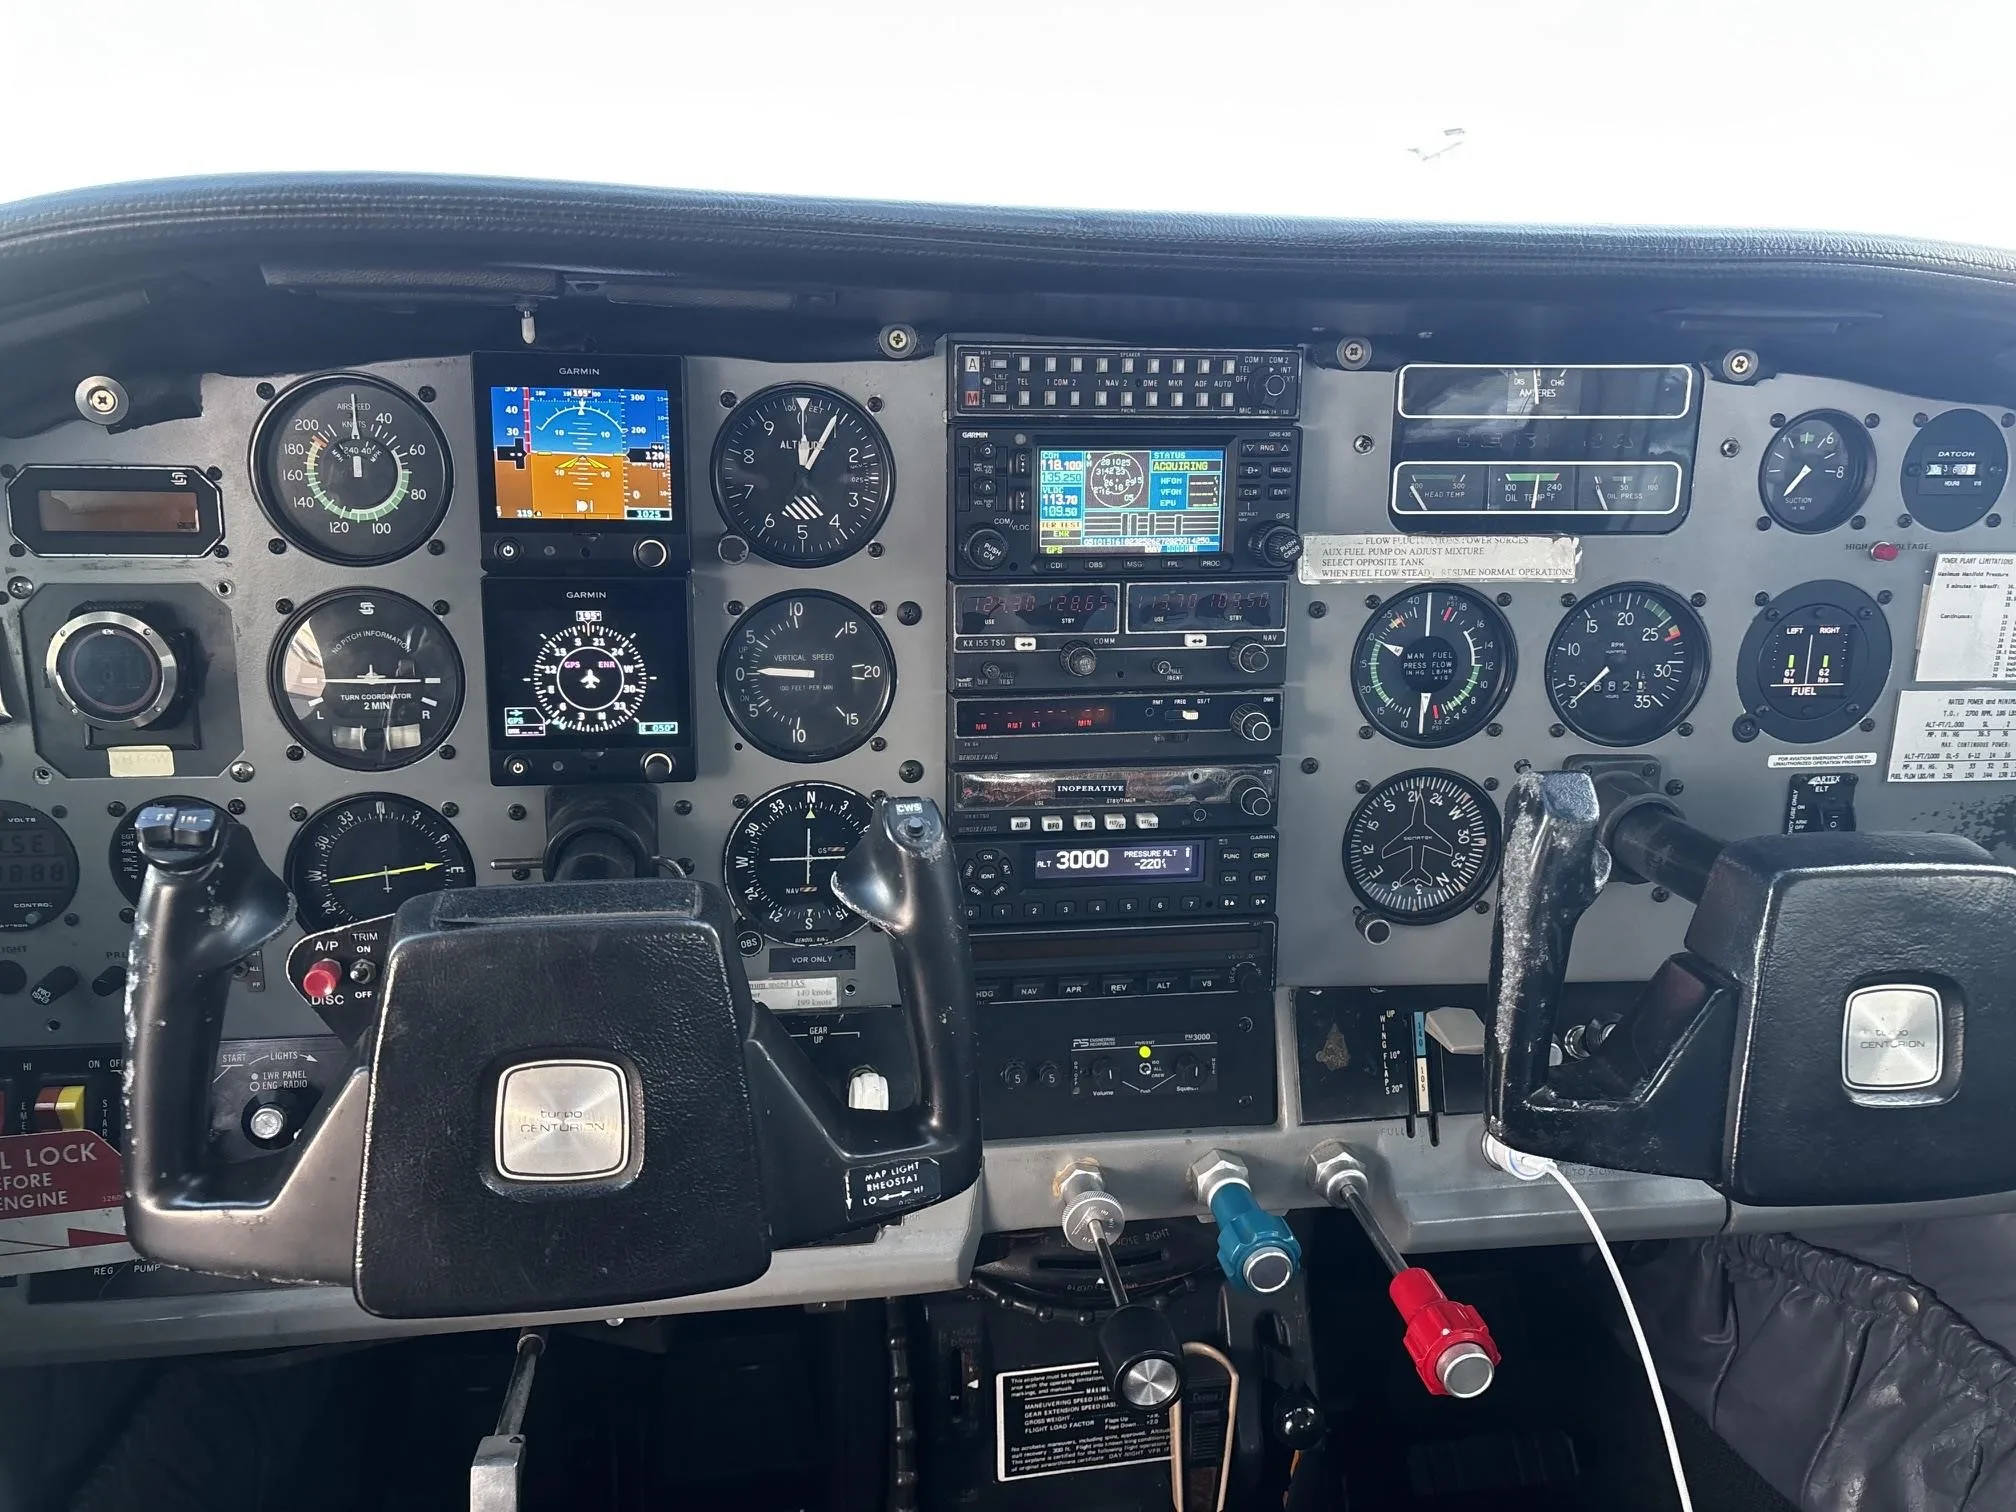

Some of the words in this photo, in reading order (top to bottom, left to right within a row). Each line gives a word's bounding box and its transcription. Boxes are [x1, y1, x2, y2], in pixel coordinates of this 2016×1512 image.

[376, 413, 392, 424] 40
[295, 419, 318, 431] 200
[764, 421, 775, 436] 9
[284, 444, 303, 454] 180
[410, 445, 425, 455] 60
[744, 449, 754, 464] 8
[849, 448, 858, 462] 2
[1042, 460, 1081, 470] 118.100
[1154, 462, 1208, 470] ACQUIRING
[283, 470, 303, 480] 160
[1042, 472, 1081, 482] 135.250
[411, 489, 426, 500] 80
[744, 485, 754, 499] 7
[294, 497, 314, 508] 140
[849, 493, 858, 507] 3
[765, 513, 775, 527] 6
[829, 514, 840, 528] 4
[330, 522, 349, 533] 120
[372, 523, 391, 534] 100
[797, 525, 808, 539] 5
[1322, 569, 1348, 577] WHEN
[1350, 569, 1372, 577] FUEL
[1374, 569, 1399, 577] FLOW
[789, 602, 803, 616] 10
[1617, 612, 1634, 626] 20
[844, 622, 857, 634] 15
[1587, 620, 1598, 633] 15
[1642, 628, 1658, 641] 25
[332, 643, 341, 654] NO
[341, 632, 362, 647] PITCH
[363, 631, 411, 653] INFORMATION
[1094, 637, 1115, 645] COMM
[774, 654, 806, 662] VERTICAL
[864, 666, 880, 678] 20
[1654, 665, 1671, 677] 30
[1791, 687, 1816, 696] FUEL
[372, 702, 390, 710] MIN
[317, 711, 324, 719] L
[422, 711, 430, 719] R
[846, 713, 859, 725] 15
[793, 729, 806, 742] 10
[1057, 785, 1124, 793] INOPERATIVE
[807, 791, 816, 803] N
[896, 803, 922, 814] CWS
[1056, 850, 1109, 869] 3000
[1124, 850, 1161, 858] PRESSURE
[736, 856, 748, 868] W
[352, 933, 378, 941] TRIM
[315, 941, 338, 951] A/P
[740, 939, 757, 949] OBS
[976, 990, 993, 998] HDG
[312, 995, 344, 1005] DISC
[223, 1053, 246, 1063] START
[270, 1051, 298, 1061] LIGHTS
[1389, 1051, 1400, 1059] 10°
[88, 1060, 100, 1069] ON
[263, 1071, 279, 1080] LWR
[283, 1070, 306, 1079] PANEL
[1392, 1085, 1403, 1093] 20°
[26, 1142, 98, 1167] LOCK
[865, 1170, 886, 1181] MAP
[891, 1162, 919, 1175] LIGHT
[867, 1174, 918, 1191] RHEOSTAT
[863, 1197, 877, 1206] LO
[94, 1266, 113, 1275] REG
[134, 1264, 160, 1272] PUMP
[1025, 1399, 1071, 1410] MANEUVERING
[1044, 1406, 1080, 1416] EXTENSION
